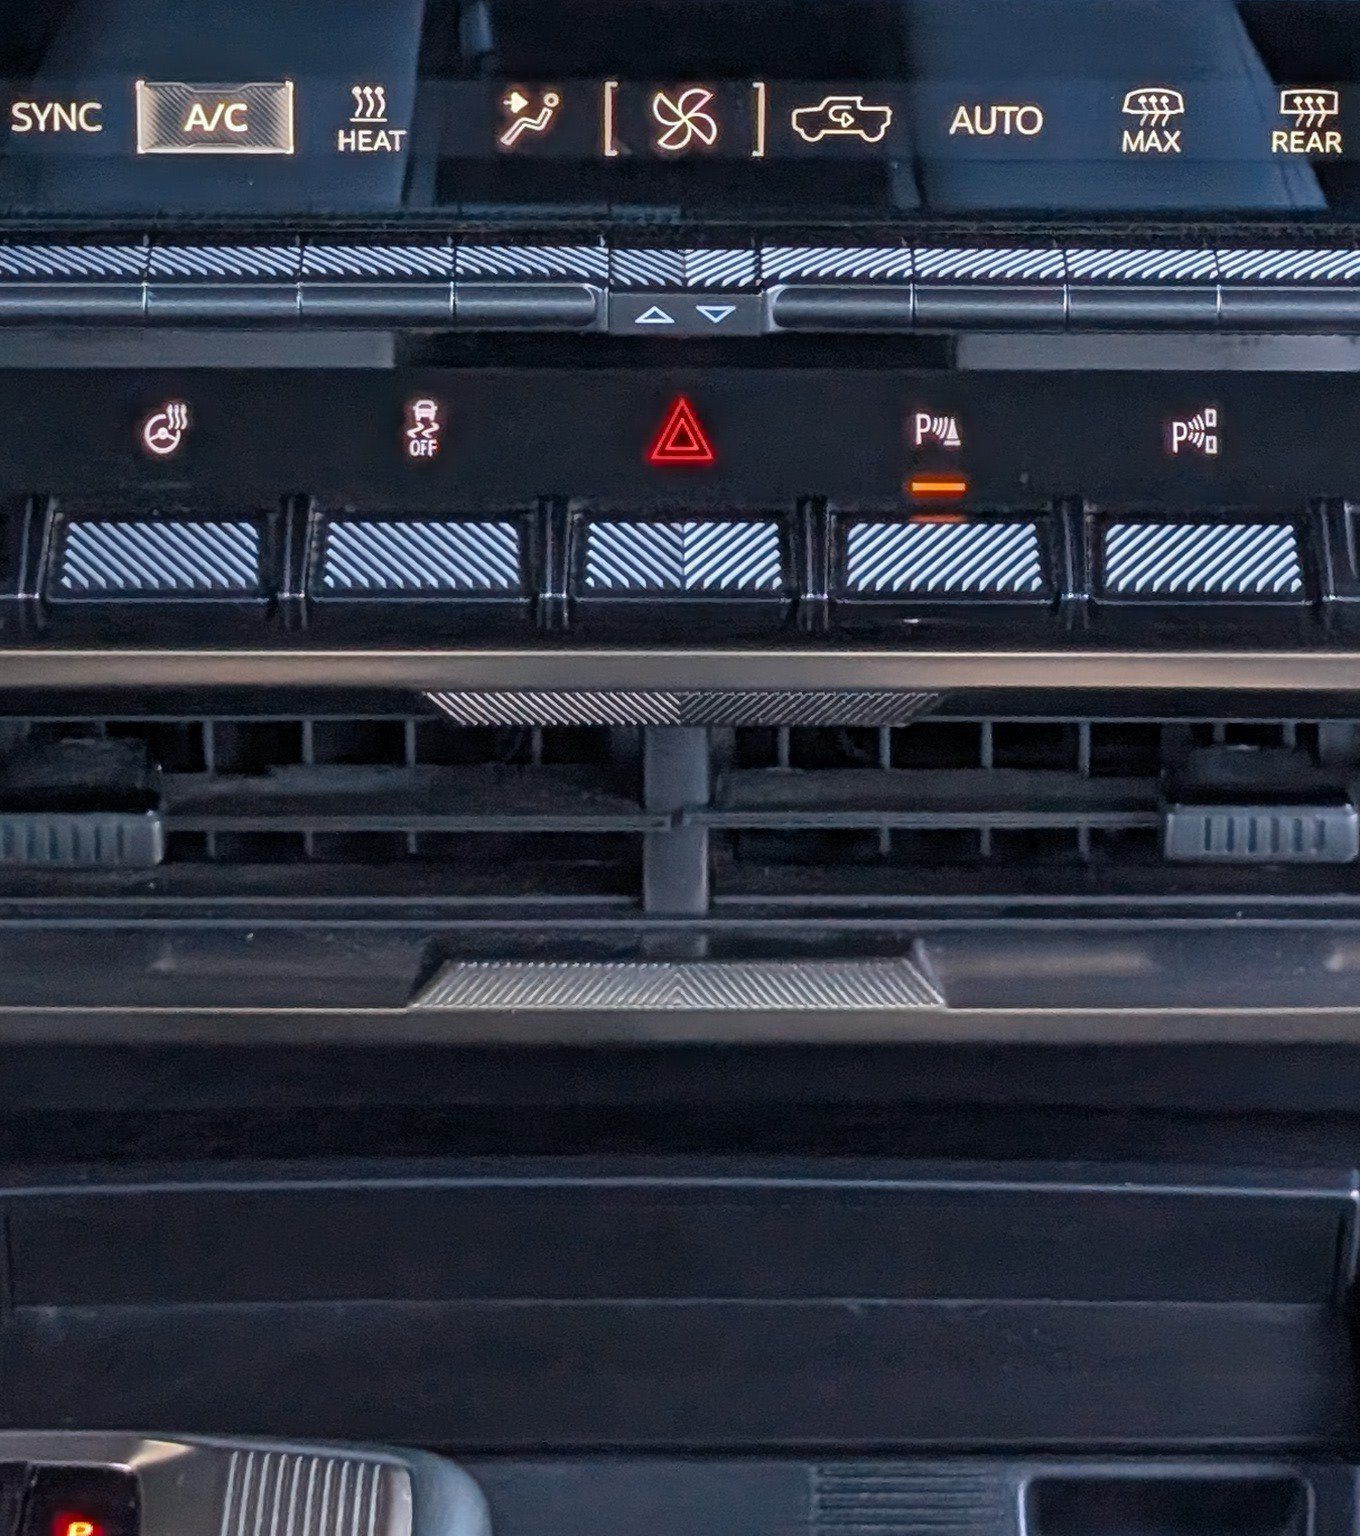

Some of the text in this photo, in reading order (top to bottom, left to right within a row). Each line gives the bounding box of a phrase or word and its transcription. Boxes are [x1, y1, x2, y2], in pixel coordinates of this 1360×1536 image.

[10, 102, 103, 132] SYNC
[184, 102, 249, 133] A/C
[949, 105, 1044, 135] AUTO
[337, 128, 408, 153] HEAT
[1122, 129, 1182, 154] MAX
[1271, 130, 1343, 155] REAR
[409, 439, 438, 456] OFF
